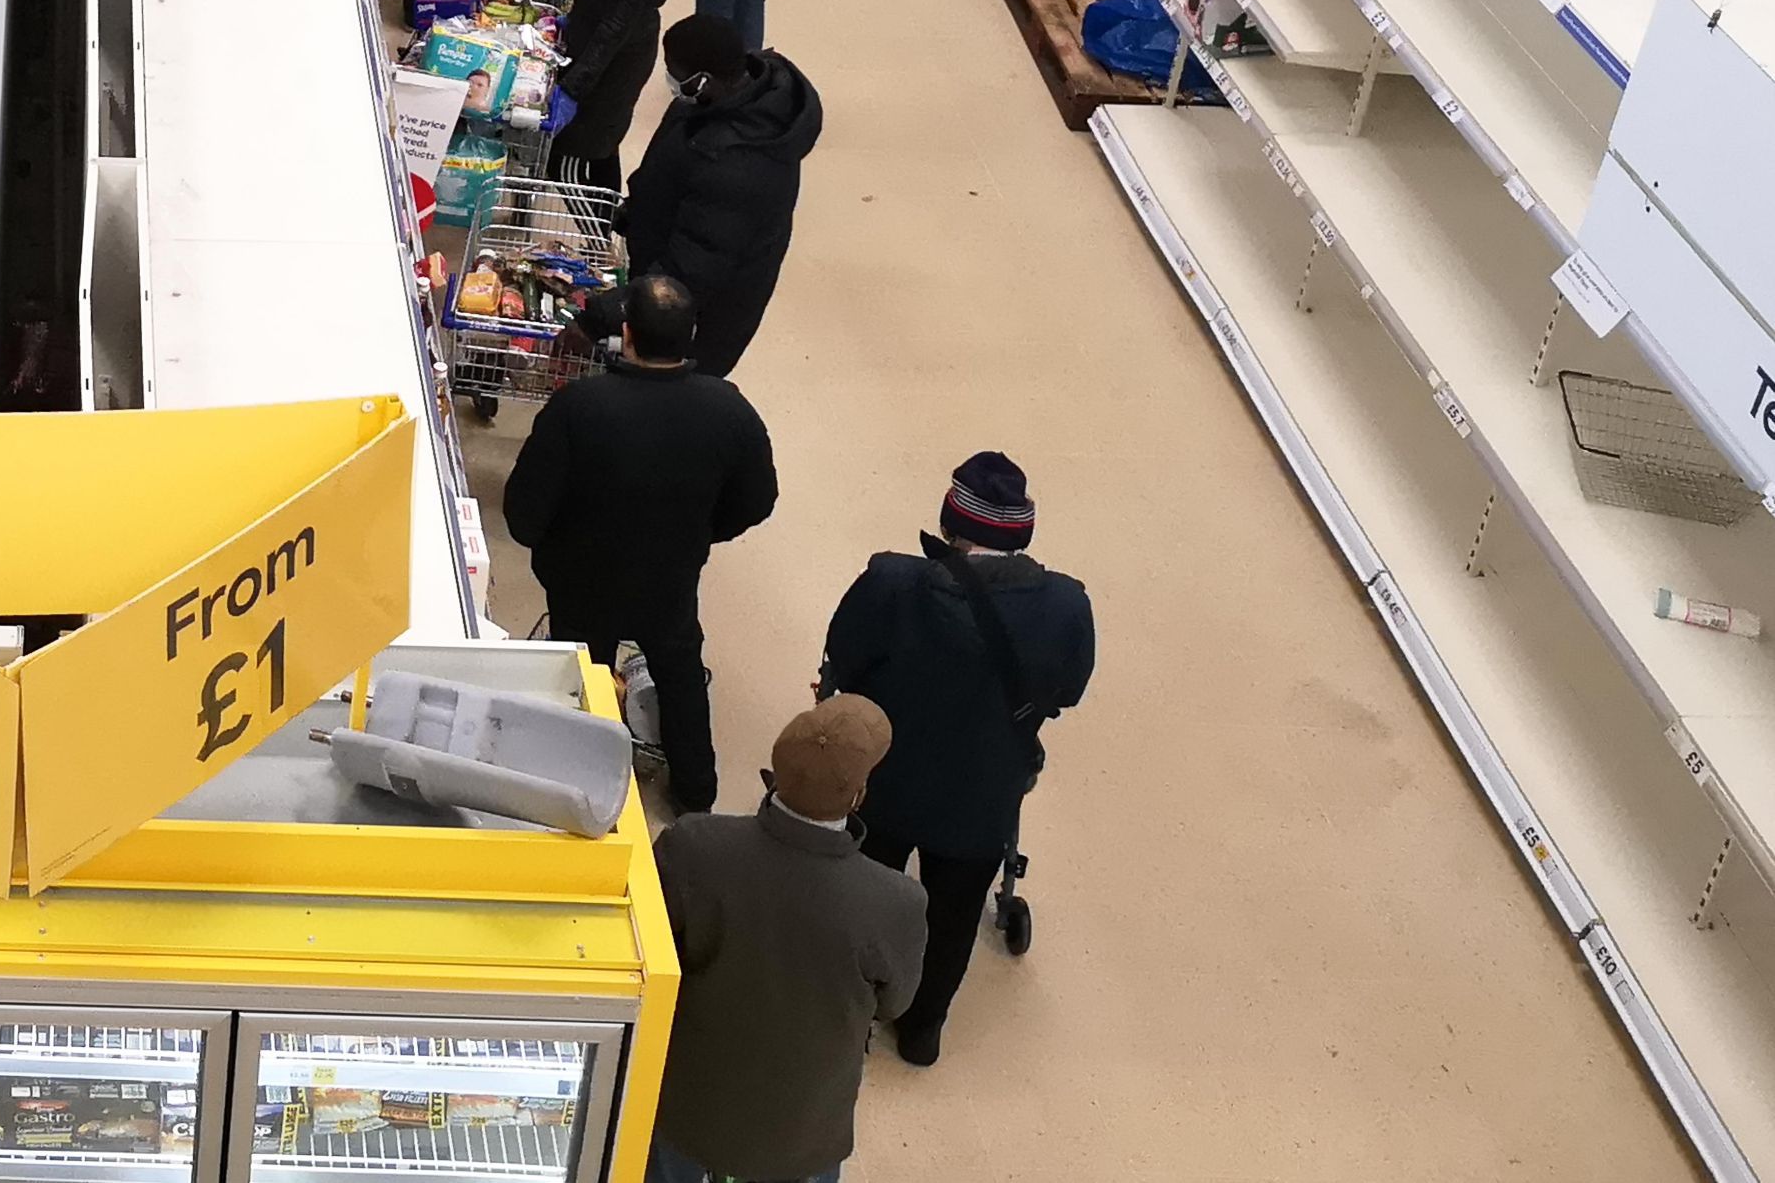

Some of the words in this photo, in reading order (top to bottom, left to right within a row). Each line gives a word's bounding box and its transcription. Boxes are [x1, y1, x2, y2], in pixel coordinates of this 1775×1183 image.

[1371, 11, 1386, 27] £2
[1443, 99, 1459, 116] £2
[401, 125, 430, 137] tched
[419, 119, 447, 131] price
[167, 525, 315, 661] From
[196, 617, 286, 764] £1
[1685, 751, 1706, 775] £5
[1522, 826, 1540, 848] £5
[1595, 946, 1617, 976] £10
[15, 1110, 76, 1125] Gastro
[431, 1091, 442, 1126] EXTR
